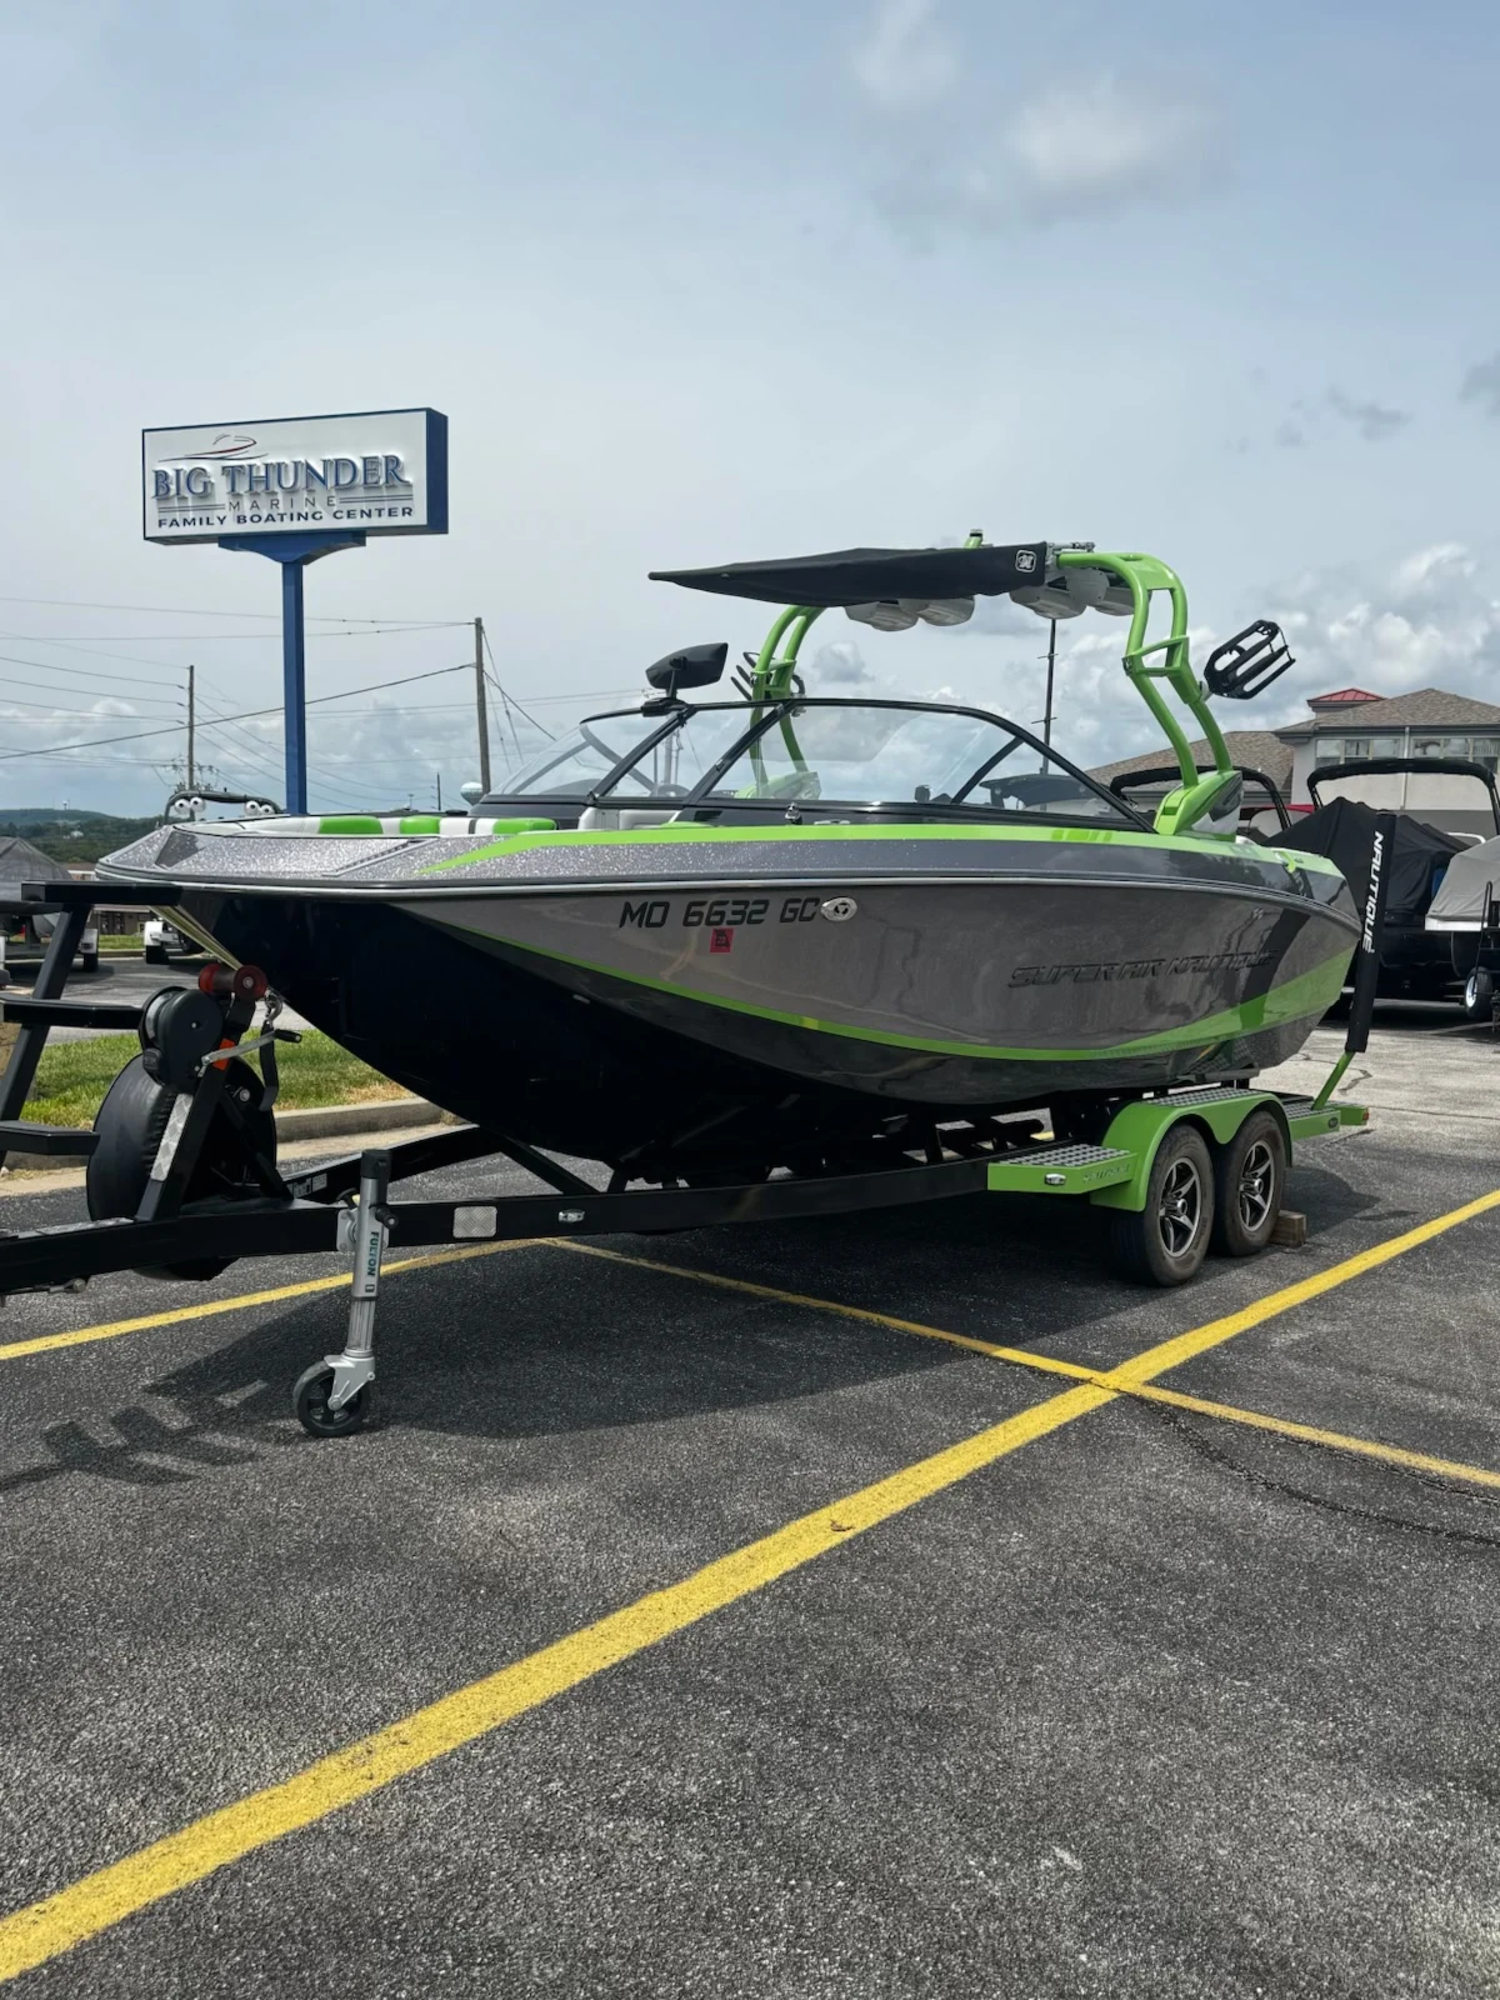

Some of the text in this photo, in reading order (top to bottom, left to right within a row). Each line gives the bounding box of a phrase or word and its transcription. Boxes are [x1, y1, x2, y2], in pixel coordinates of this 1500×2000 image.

[152, 455, 412, 499] BIG THUNDER
[158, 506, 414, 529] FAMILY BOATING CENTER
[228, 495, 336, 512] MARINE
[1362, 831, 1384, 953] NAUTIQUE
[619, 897, 820, 928] MO 6632 GC
[1008, 963, 1119, 989] SUPER
[1117, 958, 1167, 981] AIR
[367, 1231, 379, 1276] FULTON
